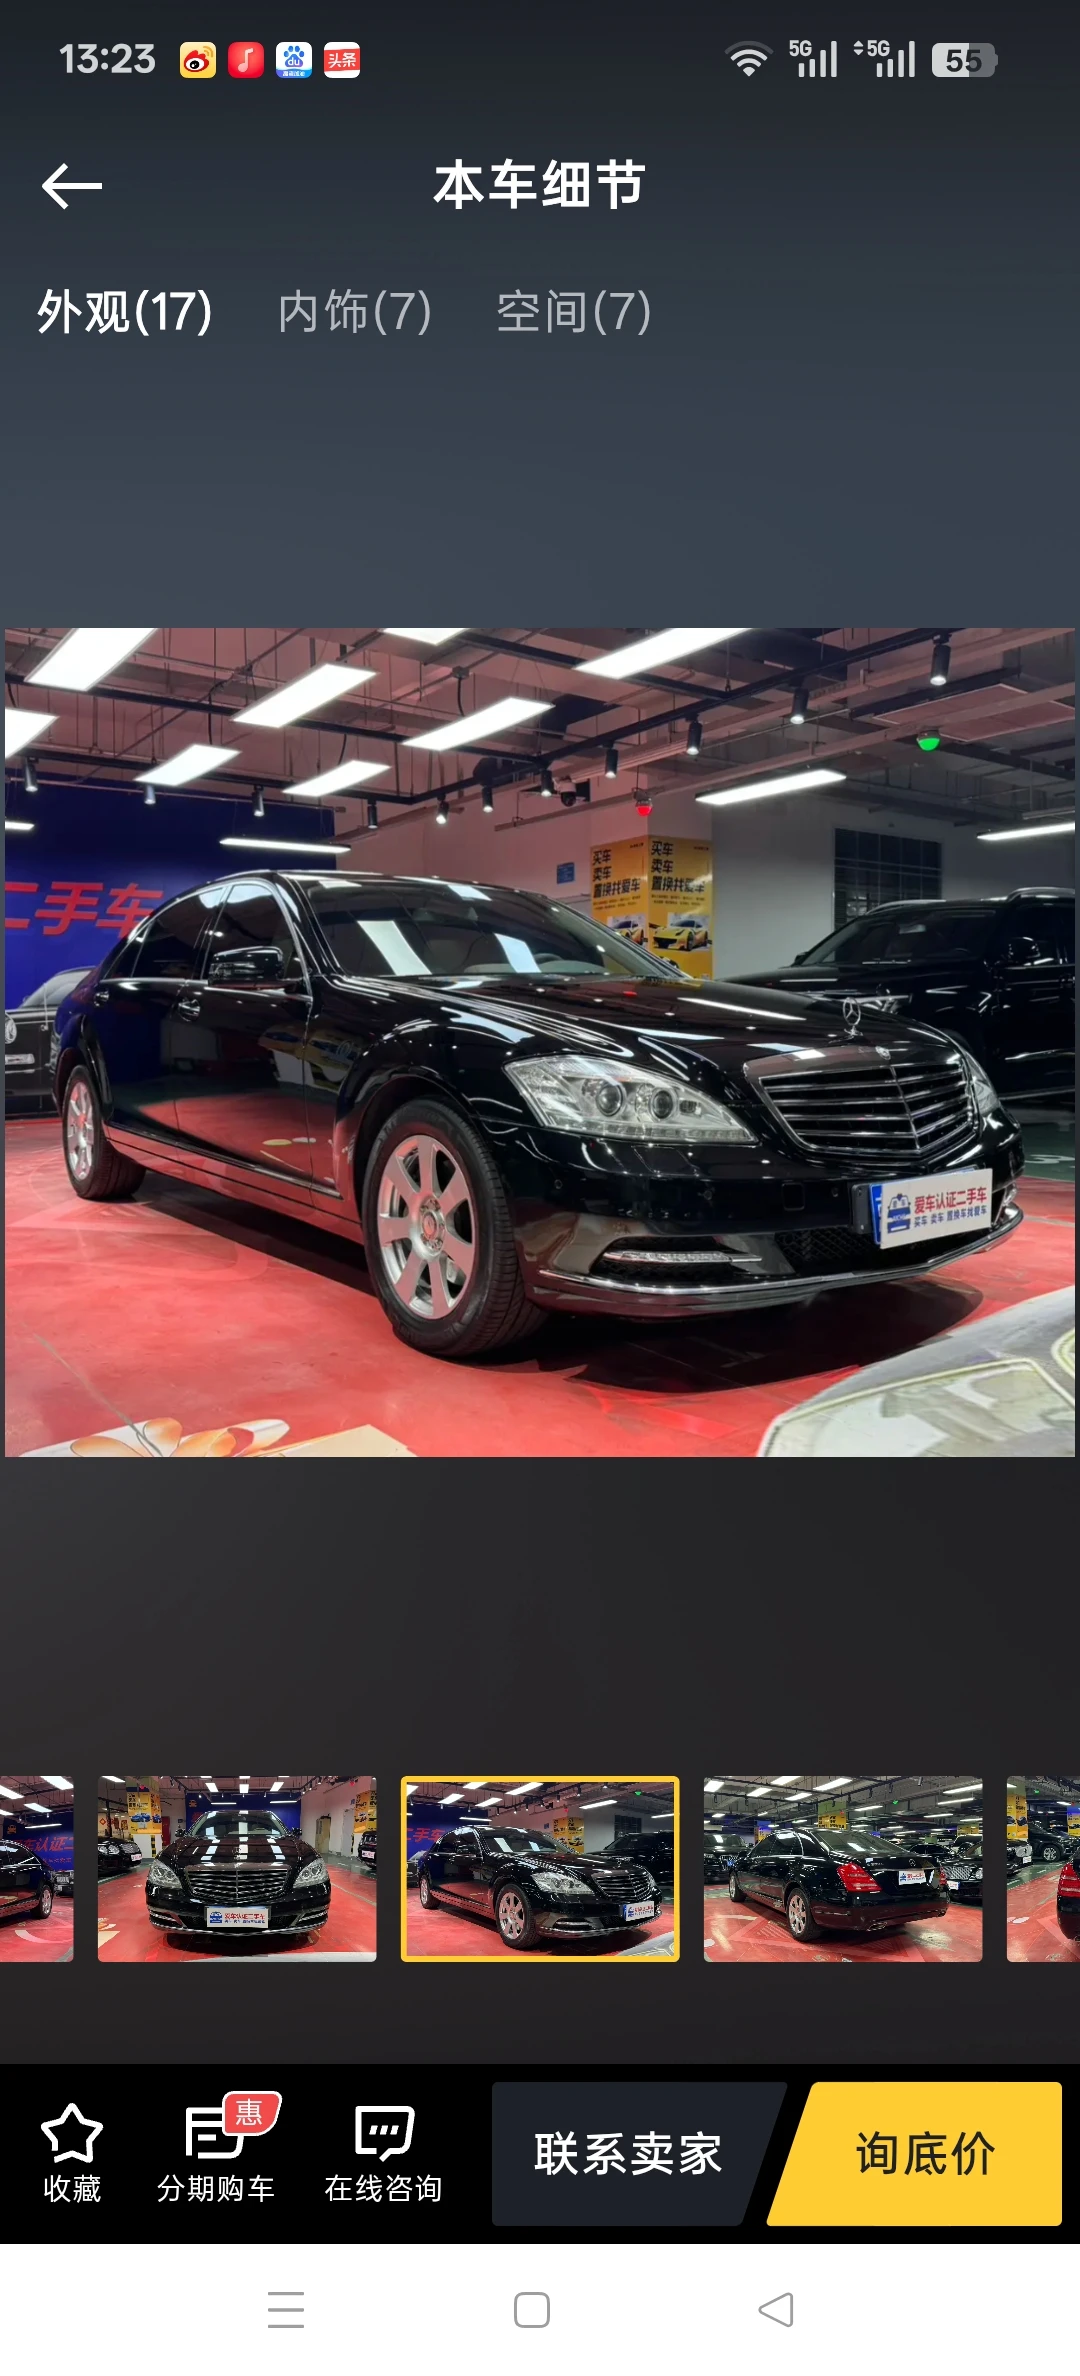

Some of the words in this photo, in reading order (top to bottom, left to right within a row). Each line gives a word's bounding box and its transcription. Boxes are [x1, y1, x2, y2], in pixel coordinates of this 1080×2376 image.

[60, 44, 155, 73] 13:23
[328, 52, 357, 69] 头条
[789, 40, 812, 57] 5G
[867, 40, 890, 57] 5G
[946, 49, 982, 72] 55
[433, 158, 645, 209] 本车细节
[37, 289, 211, 336] 外观(17)
[278, 289, 431, 336] 内饰(7)
[497, 289, 651, 336] 空间(7)
[593, 849, 612, 865] 买车
[651, 840, 674, 857] 买车
[593, 866, 612, 881] 卖车
[651, 858, 674, 873] 卖车
[593, 878, 641, 898] 置换找爱车
[5, 881, 163, 938] 二手车
[914, 1187, 988, 1215] 爱车认证二手车
[914, 1215, 928, 1228] 买车
[236, 2099, 263, 2126] 惠
[534, 2131, 723, 2176] 联系卖家
[856, 2131, 996, 2176] 询底价
[43, 2174, 102, 2203] 收藏
[157, 2174, 275, 2203] 分期购车
[324, 2174, 442, 2203] 在线咨询
